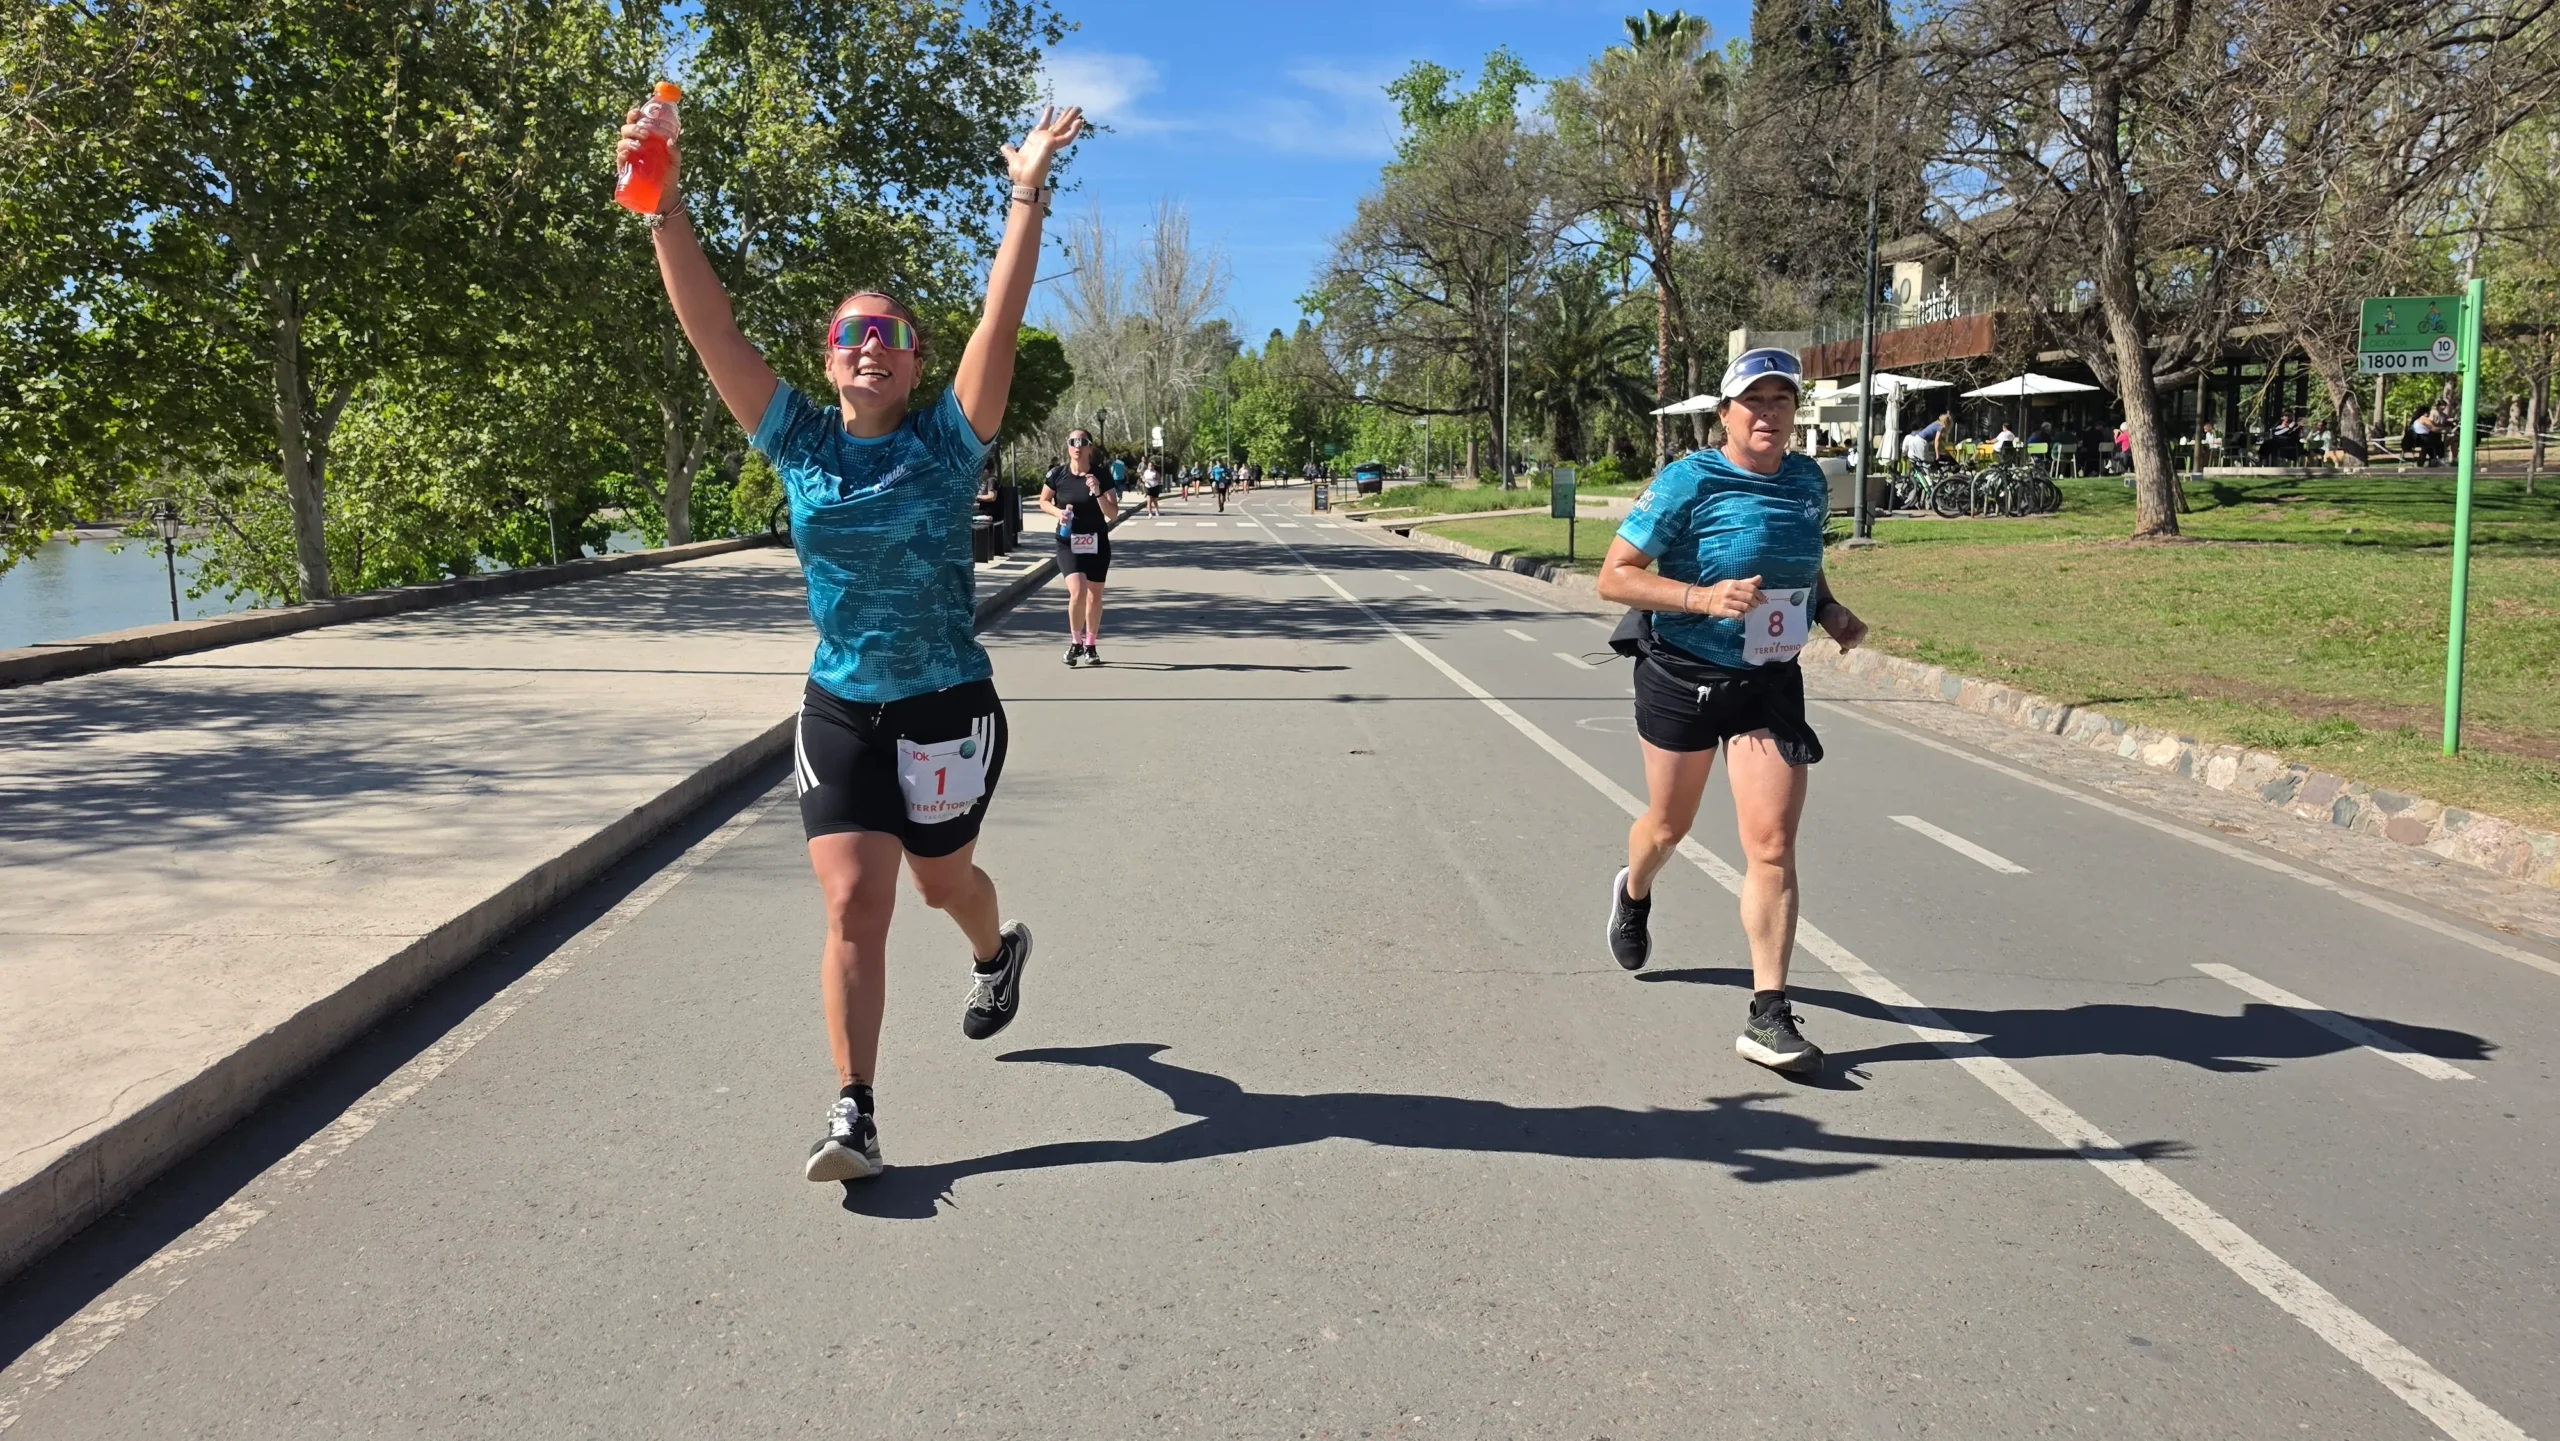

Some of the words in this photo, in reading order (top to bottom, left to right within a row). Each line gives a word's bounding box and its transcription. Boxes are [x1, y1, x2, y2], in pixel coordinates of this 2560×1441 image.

[2438, 341, 2451, 352] 10
[2368, 354, 2407, 369] 1800
[2412, 355, 2428, 367] m
[1074, 536, 1094, 545] 220
[1768, 610, 1784, 637] 8
[934, 766, 947, 796] 1
